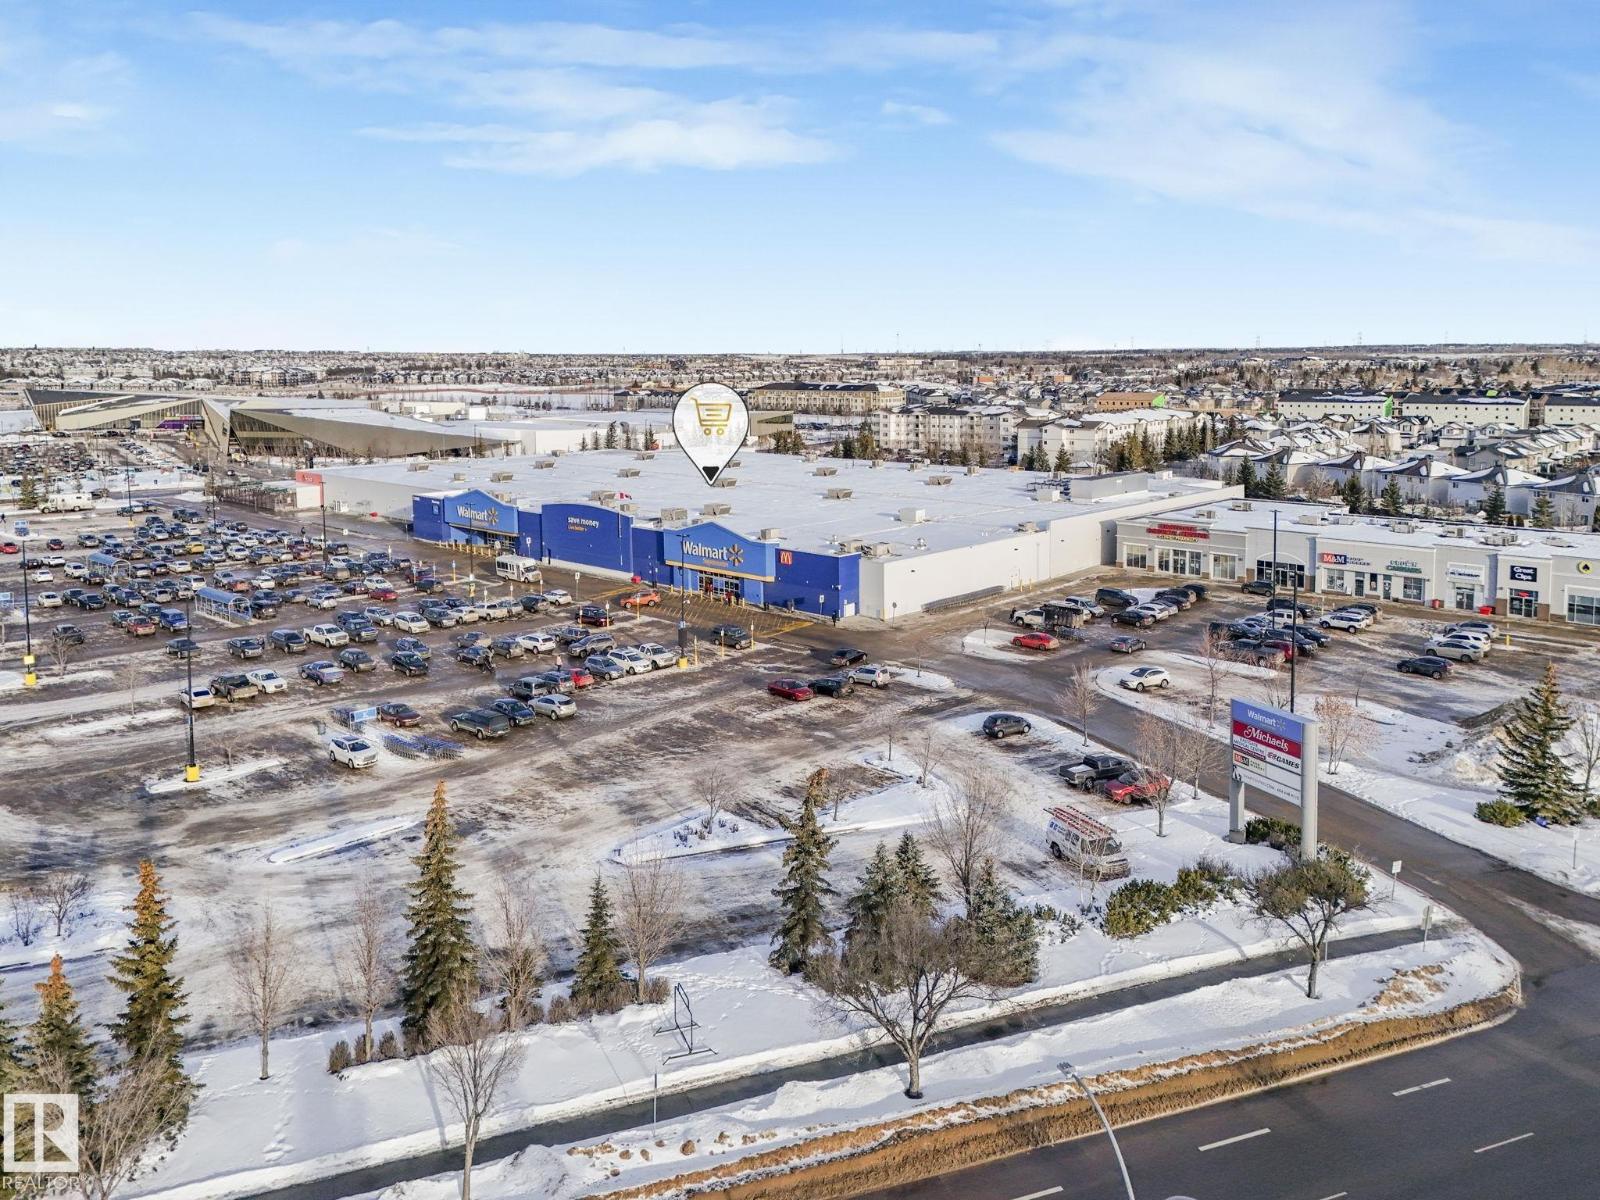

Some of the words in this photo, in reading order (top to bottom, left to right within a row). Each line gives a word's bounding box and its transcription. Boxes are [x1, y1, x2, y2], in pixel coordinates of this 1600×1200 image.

[457, 505, 488, 521] Walmart
[683, 540, 728, 560] Walmart
[1323, 554, 1346, 565] M&M
[1247, 709, 1277, 727] Walmart
[1244, 725, 1289, 752] Michaels
